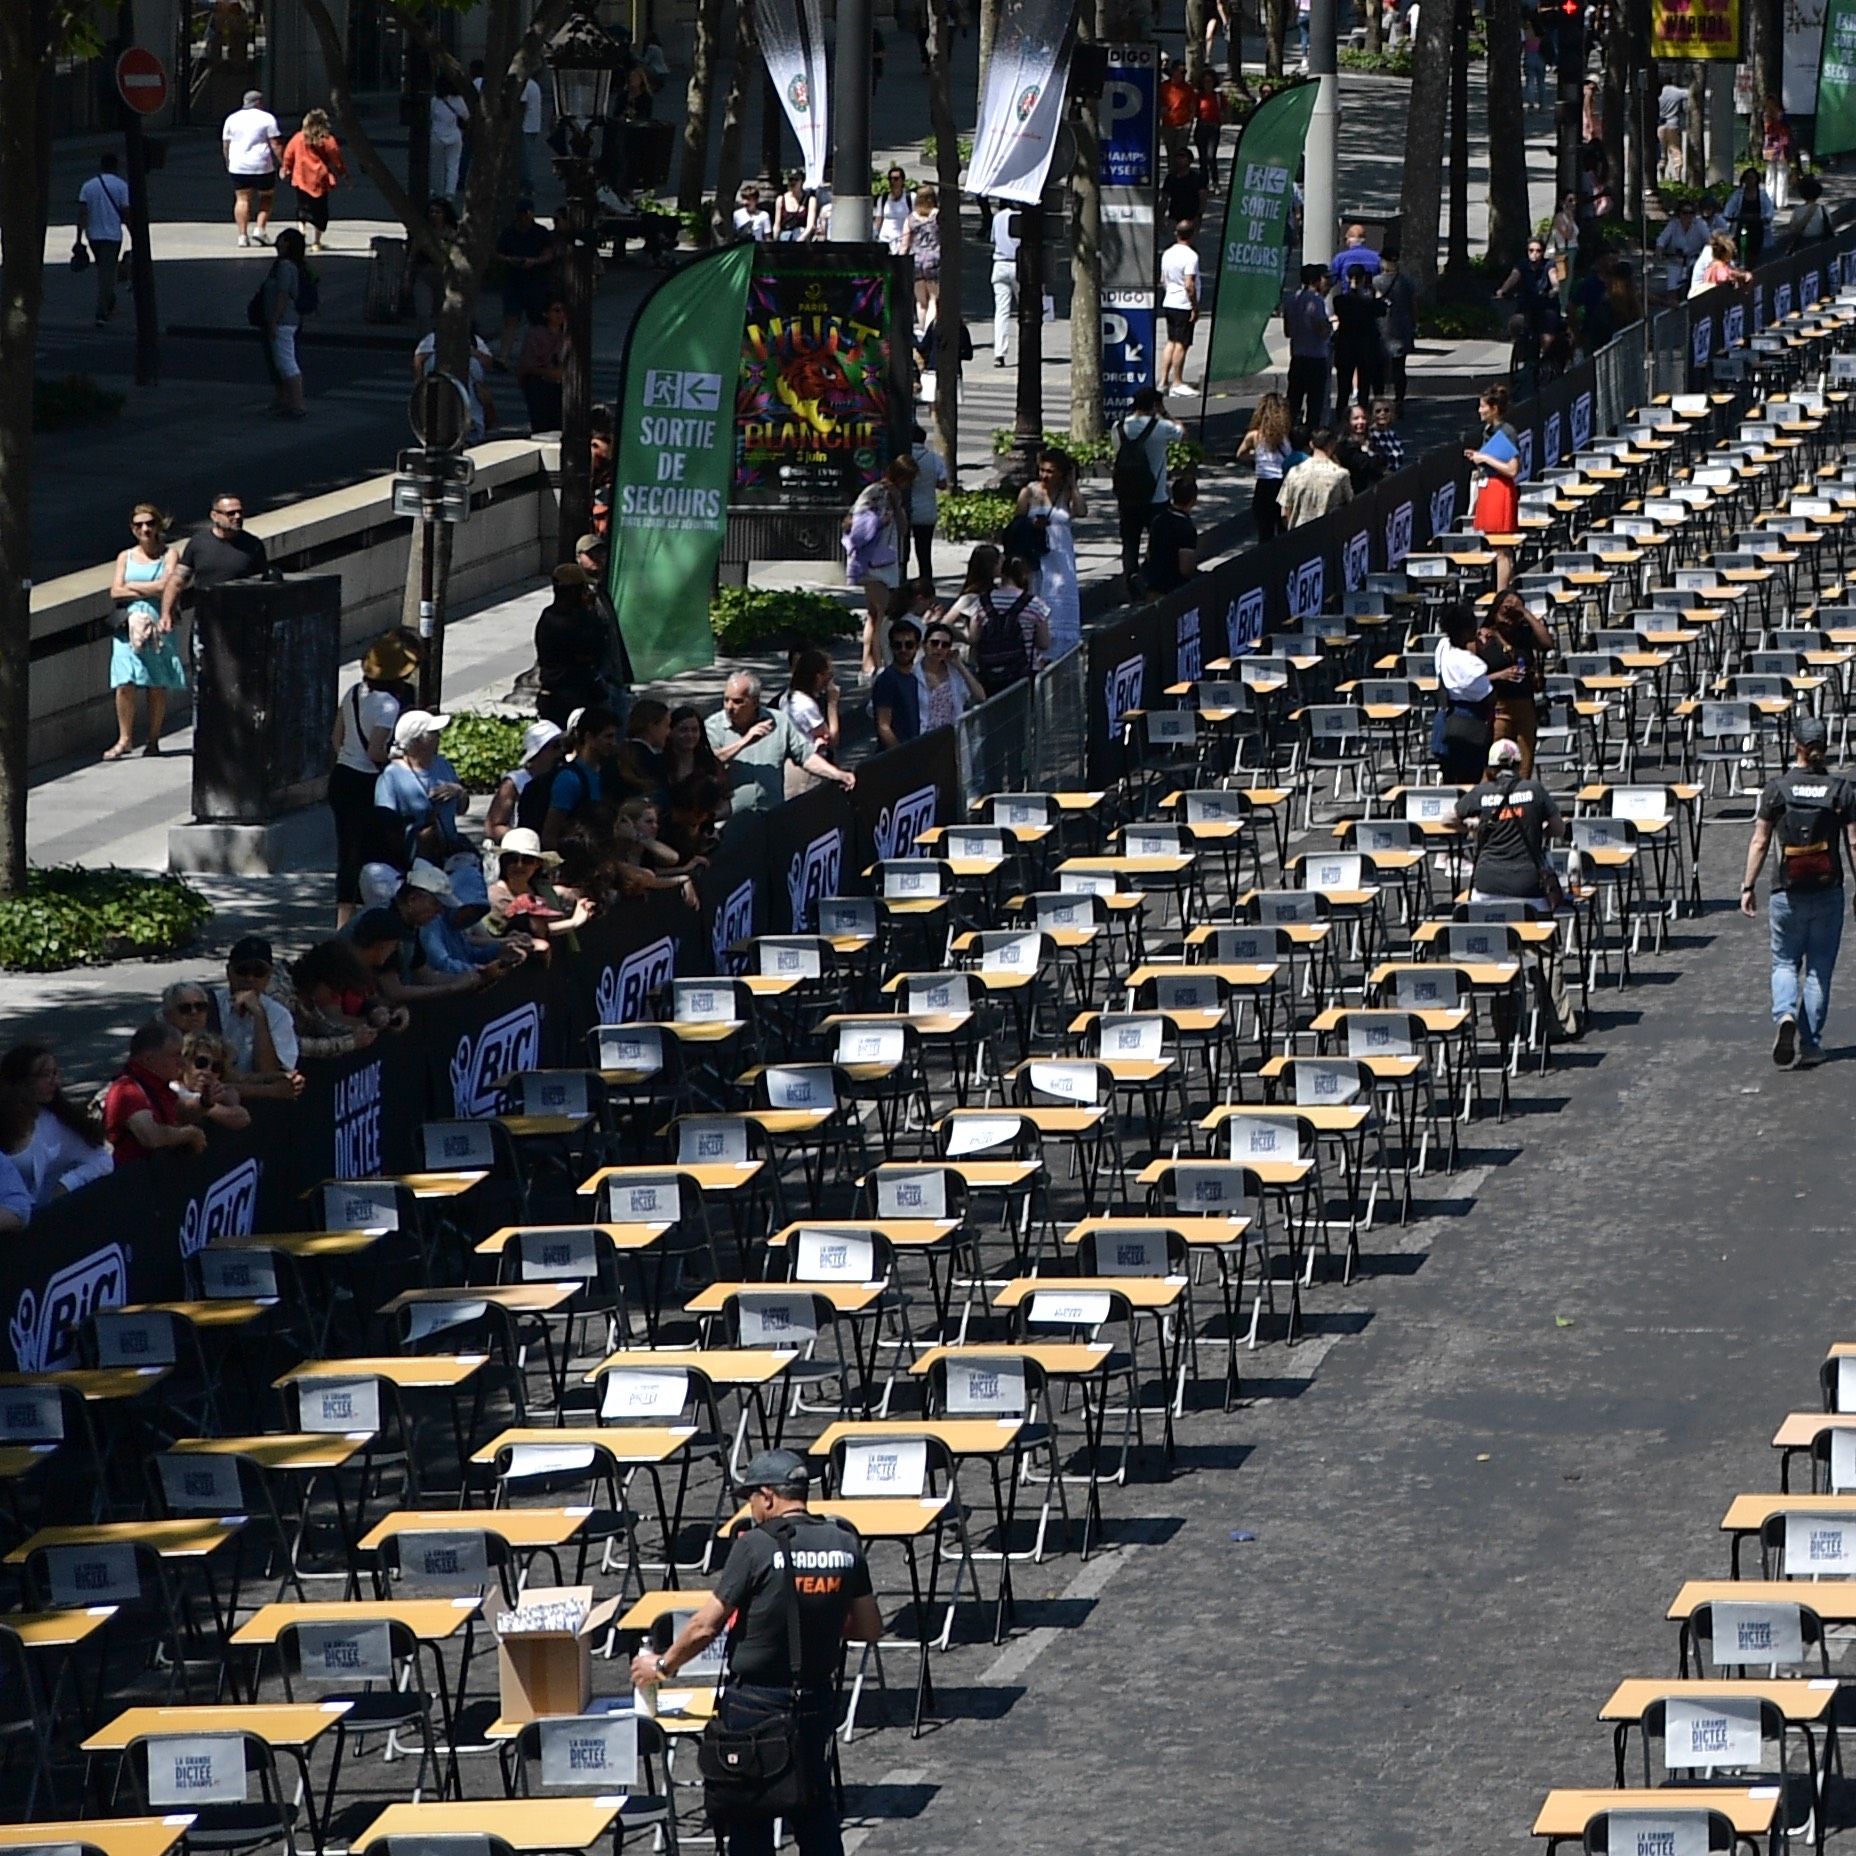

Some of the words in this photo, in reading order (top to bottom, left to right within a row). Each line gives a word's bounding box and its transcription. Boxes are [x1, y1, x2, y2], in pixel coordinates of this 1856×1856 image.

[1666, 16, 1726, 34] WARHOL
[1841, 49, 1854, 64] DE
[1098, 81, 1142, 140] P
[1241, 195, 1281, 219] SORTIE
[1248, 220, 1265, 241] DE
[1228, 243, 1278, 268] SECOURS
[747, 316, 881, 362] NUIT
[640, 416, 716, 449] SORTIE
[744, 422, 879, 449] BLANCHE
[657, 451, 687, 481] DE
[622, 485, 721, 518] SECOURS
[335, 1078, 346, 1120] LA
[350, 1059, 381, 1116] GRANDE
[335, 1104, 381, 1179] DICTÉE
[795, 1576, 841, 1594] TEAM
[1701, 1720, 1728, 1729] GRANDE
[579, 1739, 606, 1748] GRANDE
[1692, 1729, 1728, 1744] DICTÉE
[185, 1756, 212, 1766] GRANDE
[570, 1748, 606, 1761] DICTÉE
[175, 1766, 212, 1780] DICTÉE
[1648, 1831, 1675, 1841] GRANDE
[1637, 1840, 1675, 1856] DICTÉE
